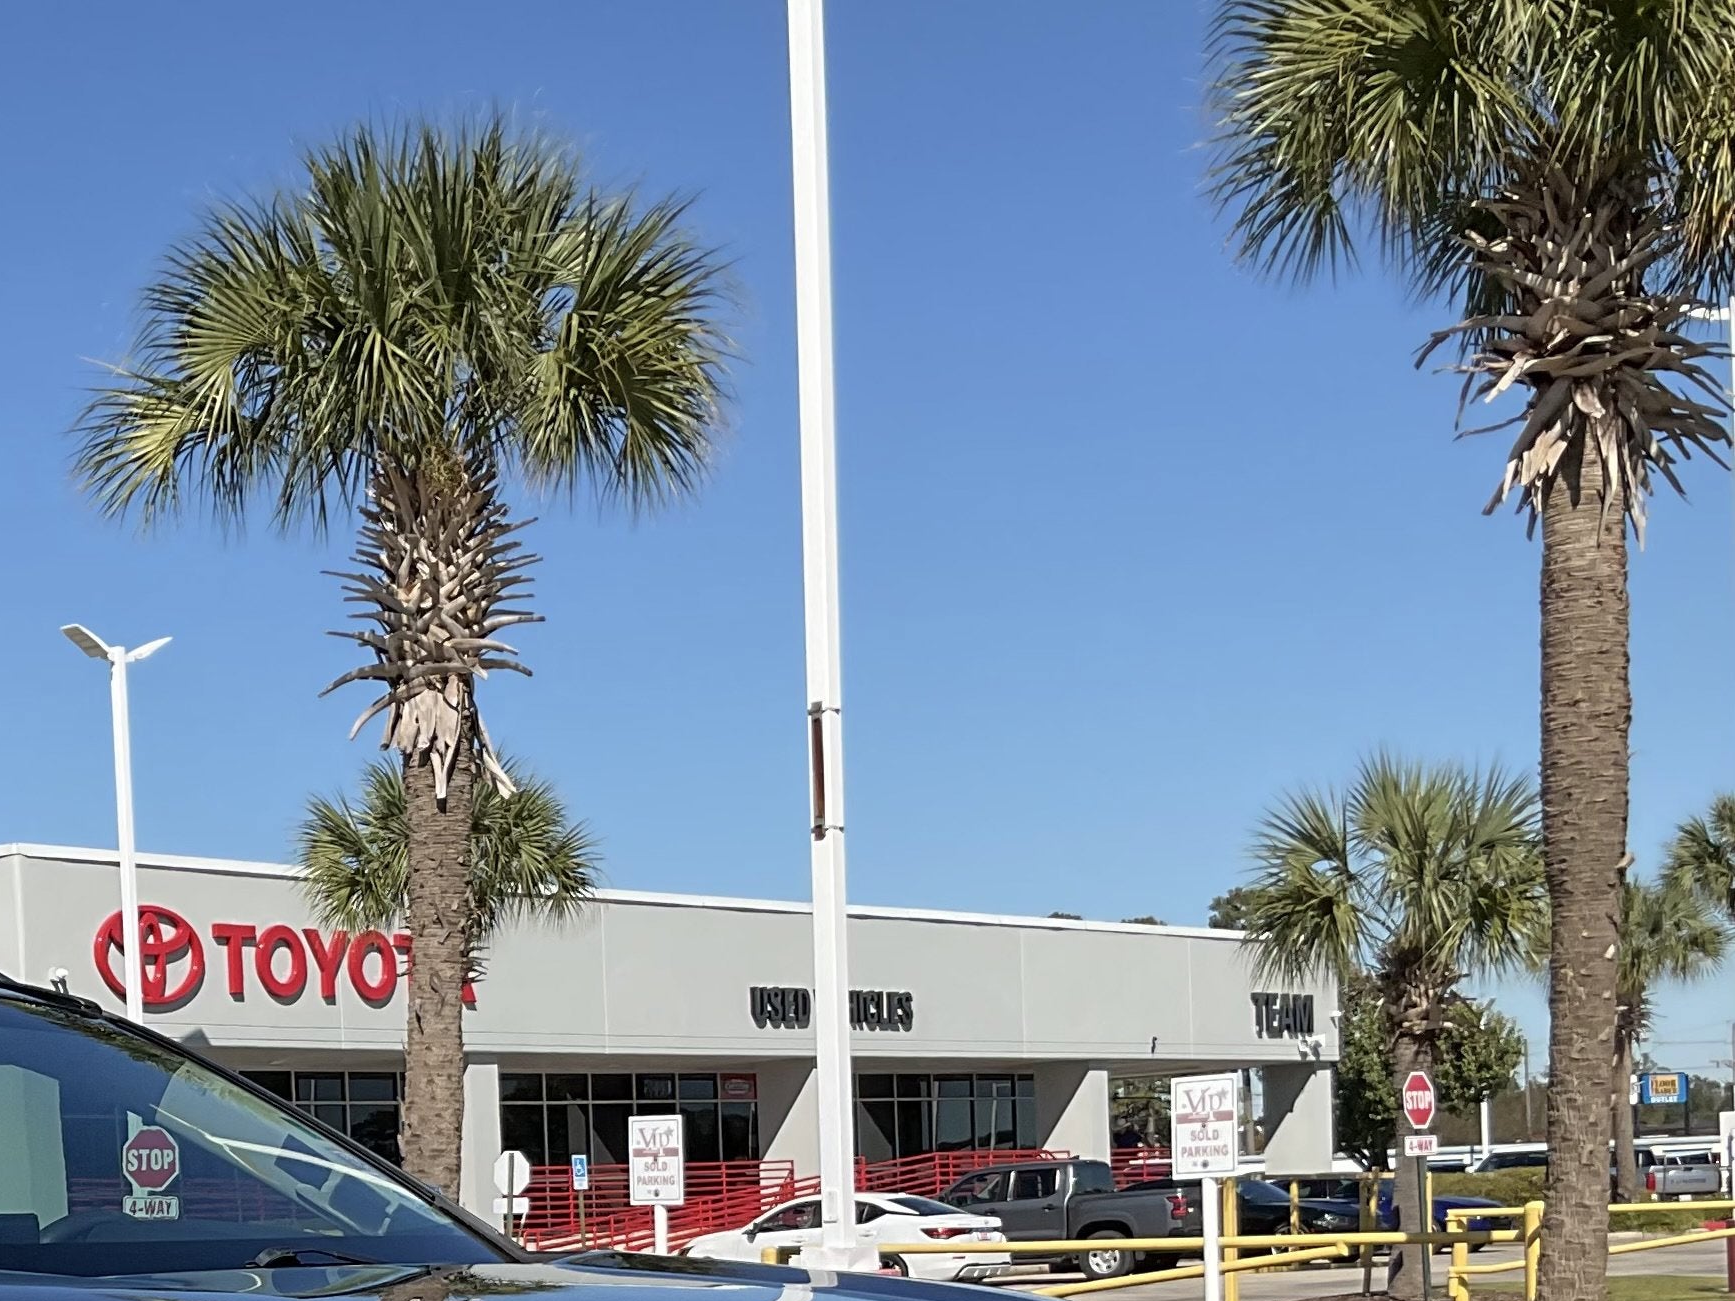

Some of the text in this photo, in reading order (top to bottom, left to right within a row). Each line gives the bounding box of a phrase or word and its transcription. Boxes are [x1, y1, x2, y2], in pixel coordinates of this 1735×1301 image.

[211, 922, 477, 1008] TOYO
[750, 986, 913, 1032] USED HICLES
[1250, 992, 1314, 1039] TEAM
[1406, 1090, 1431, 1110] STOP
[1190, 1129, 1219, 1142] SOLD
[1181, 1144, 1229, 1158] PARKING
[1408, 1139, 1433, 1153] 4-WAY
[127, 1148, 174, 1172] STOP
[644, 1161, 668, 1172] SOLD
[636, 1175, 676, 1186] PARKING
[129, 1199, 172, 1216] 4-WAY
